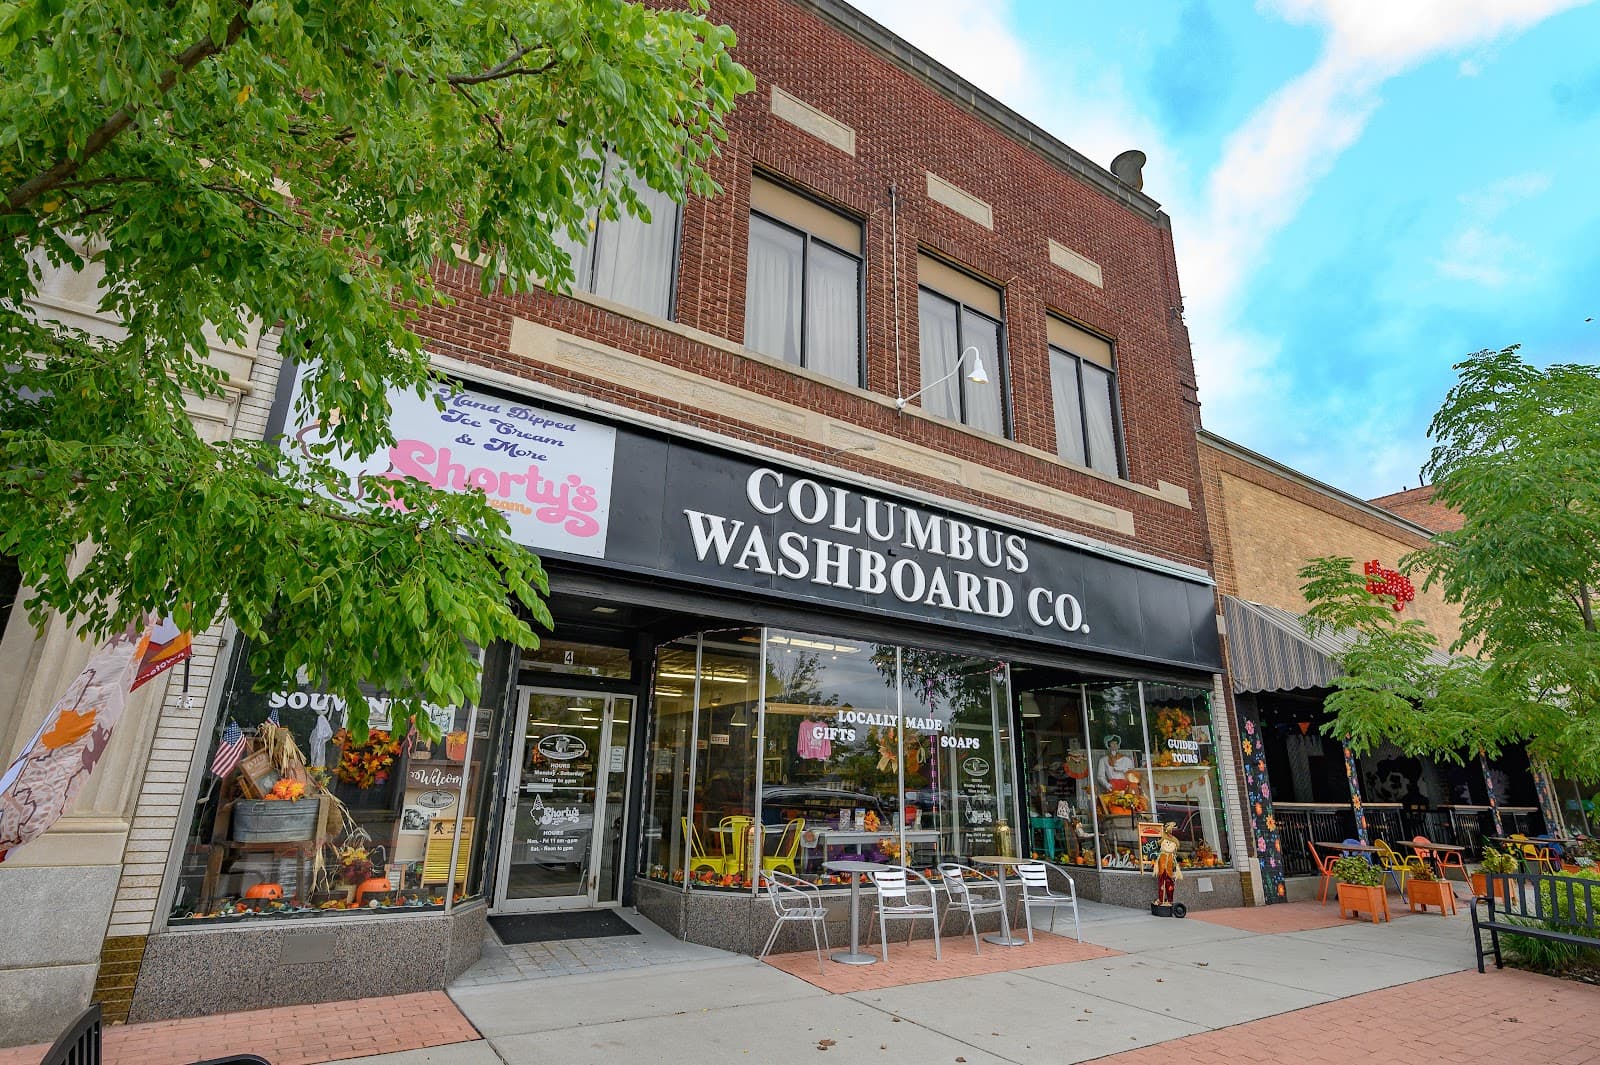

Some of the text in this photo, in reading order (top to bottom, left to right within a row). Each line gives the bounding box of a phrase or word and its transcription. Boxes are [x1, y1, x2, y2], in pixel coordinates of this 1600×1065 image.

[439, 388, 577, 432] Hand Dipped
[440, 410, 565, 447] Ice Cream
[455, 434, 548, 461] & More
[376, 440, 600, 537] Shorty's
[746, 468, 1029, 573] COLUMBUS
[683, 510, 1091, 634] WASHBOARD CO.
[838, 710, 943, 731] LOCALLY MADE
[812, 726, 857, 742] GIFTS
[940, 736, 980, 749] SOAPS
[1168, 739, 1198, 750] GUIDED
[1172, 753, 1198, 763] TOURS
[410, 768, 463, 786] Welcom
